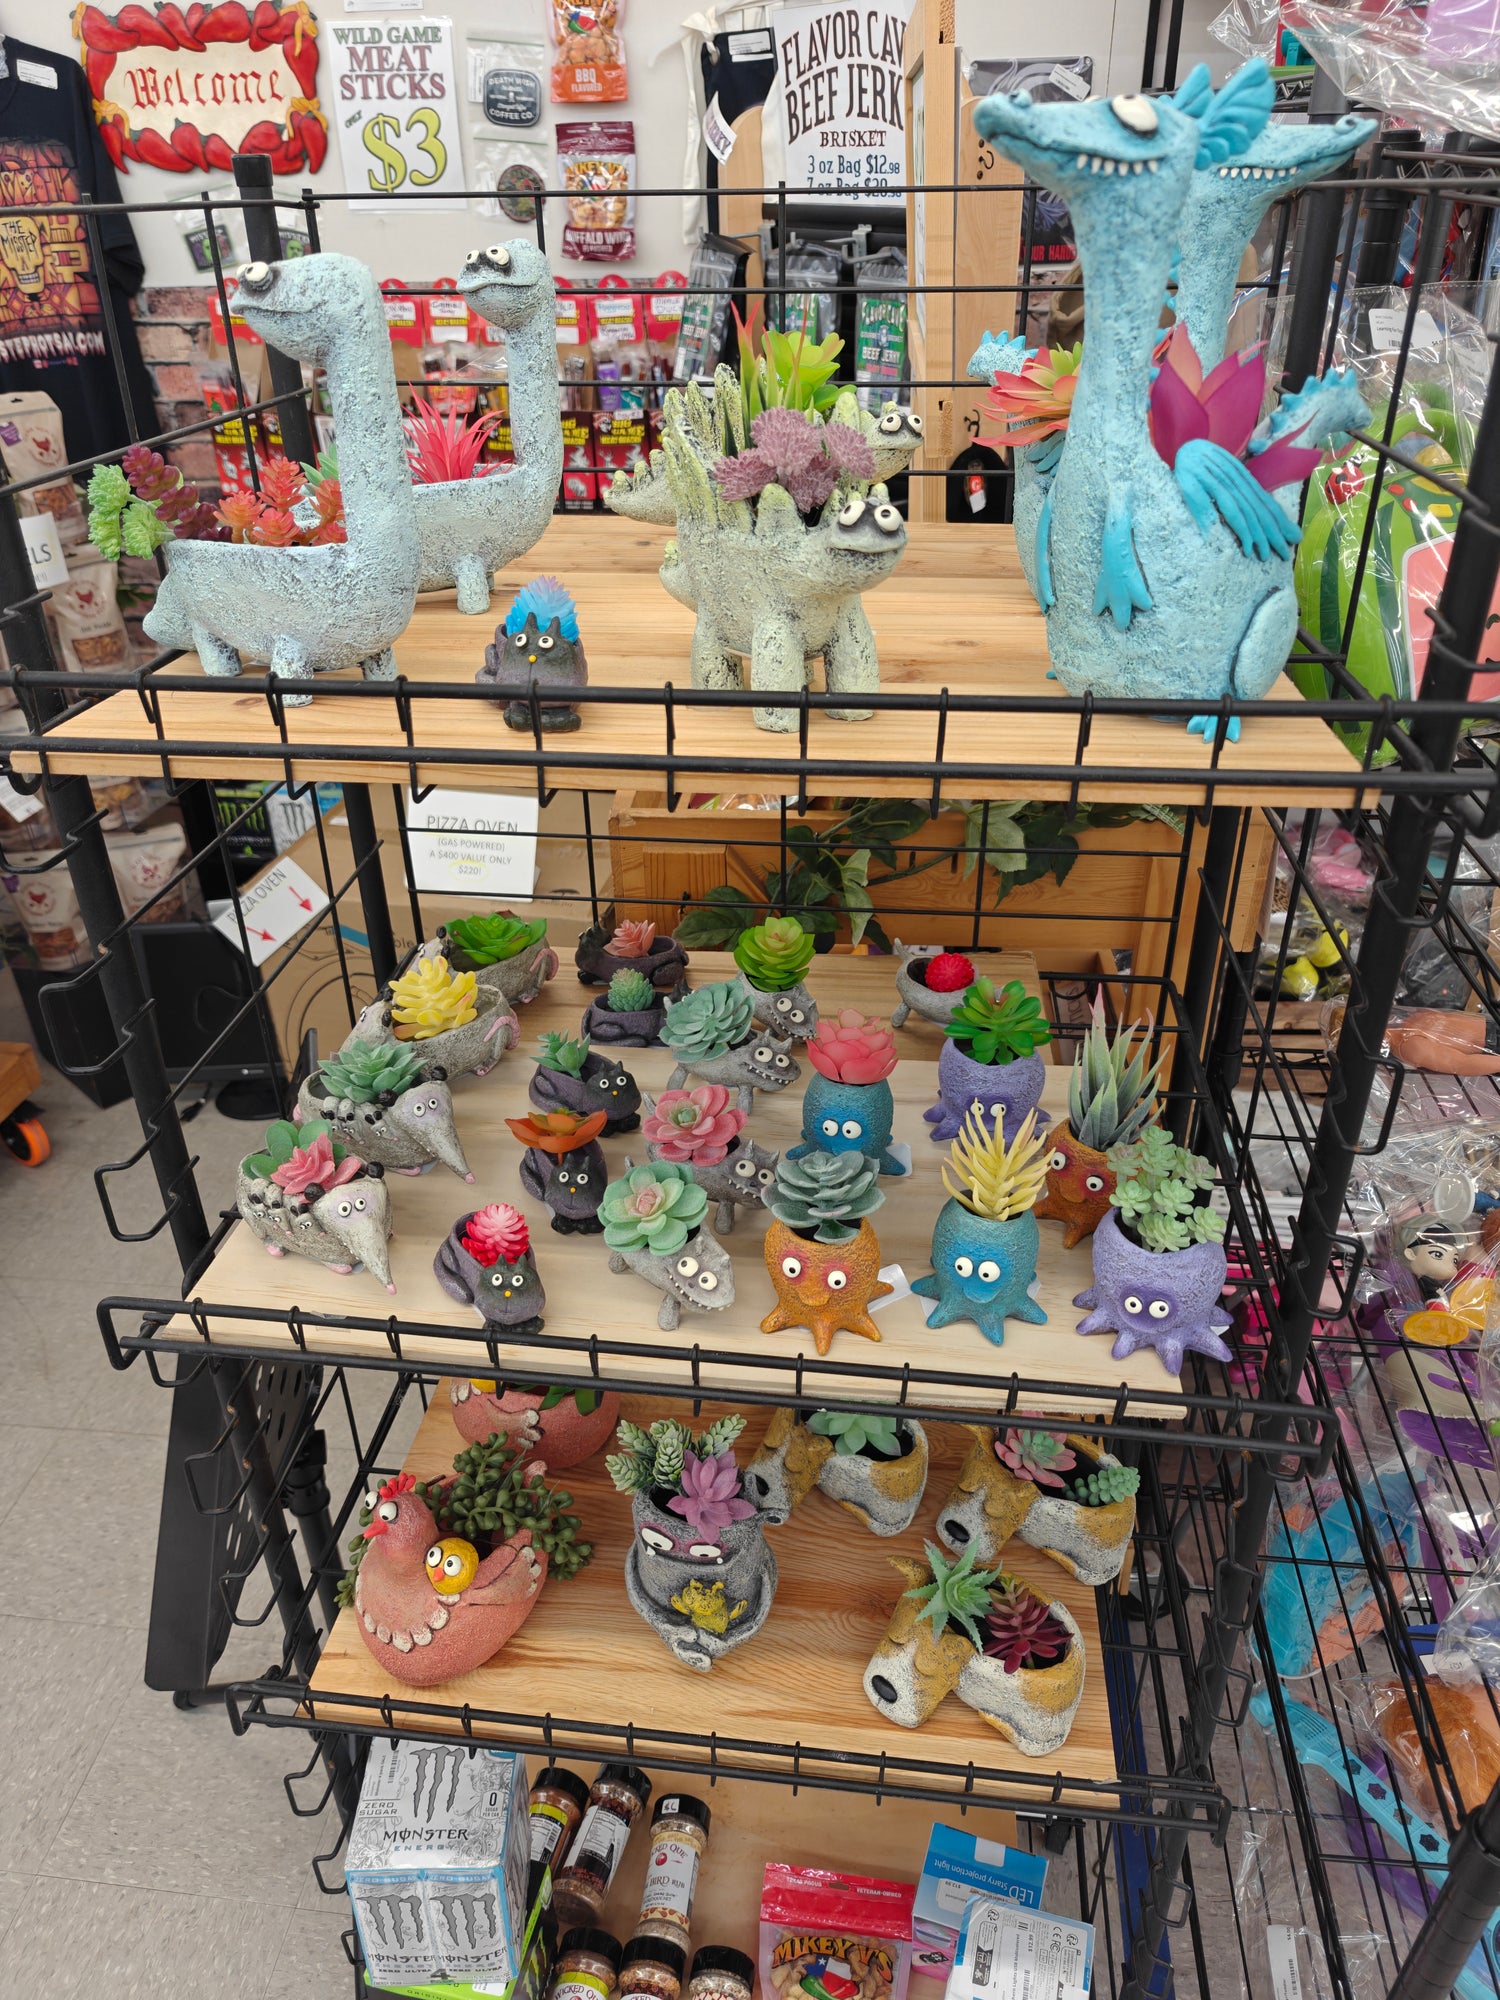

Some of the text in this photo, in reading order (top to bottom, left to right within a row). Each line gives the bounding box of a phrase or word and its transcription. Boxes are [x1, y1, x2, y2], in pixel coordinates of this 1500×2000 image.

[333, 26, 442, 45] WILD GAME
[781, 9, 862, 88] FLAVOR
[346, 45, 432, 72] MEAT
[575, 68, 597, 84] BBQ
[124, 66, 286, 110] Welcome
[339, 73, 446, 100] STICKS
[785, 64, 838, 145] BEEF
[489, 108, 520, 120] COFFEE
[820, 129, 887, 147] BRISKET
[362, 107, 447, 194] $3
[807, 154, 900, 177] 3 oz Bag $12.98
[1, 219, 23, 235] THE
[426, 815, 518, 833] PIZZA OVEN
[438, 838, 505, 852] (GAS POWERED)
[438, 850, 459, 860] $400
[460, 852, 486, 863] VALUE
[489, 855, 512, 865] ONLY
[458, 865, 482, 876] $220!
[226, 868, 287, 924] PZZA OVEN
[489, 1792, 497, 1806] 0
[383, 1827, 469, 1843] MONSTER
[934, 1859, 951, 1870] light
[952, 1865, 987, 1881] projection
[856, 1887, 902, 1898] VETERAN-OWNED
[1009, 1885, 1034, 1904] LED
[367, 1951, 435, 1964] MONSTER
[772, 1936, 893, 1984] MIKEY V'S
[554, 1984, 585, 2000] WICKED
